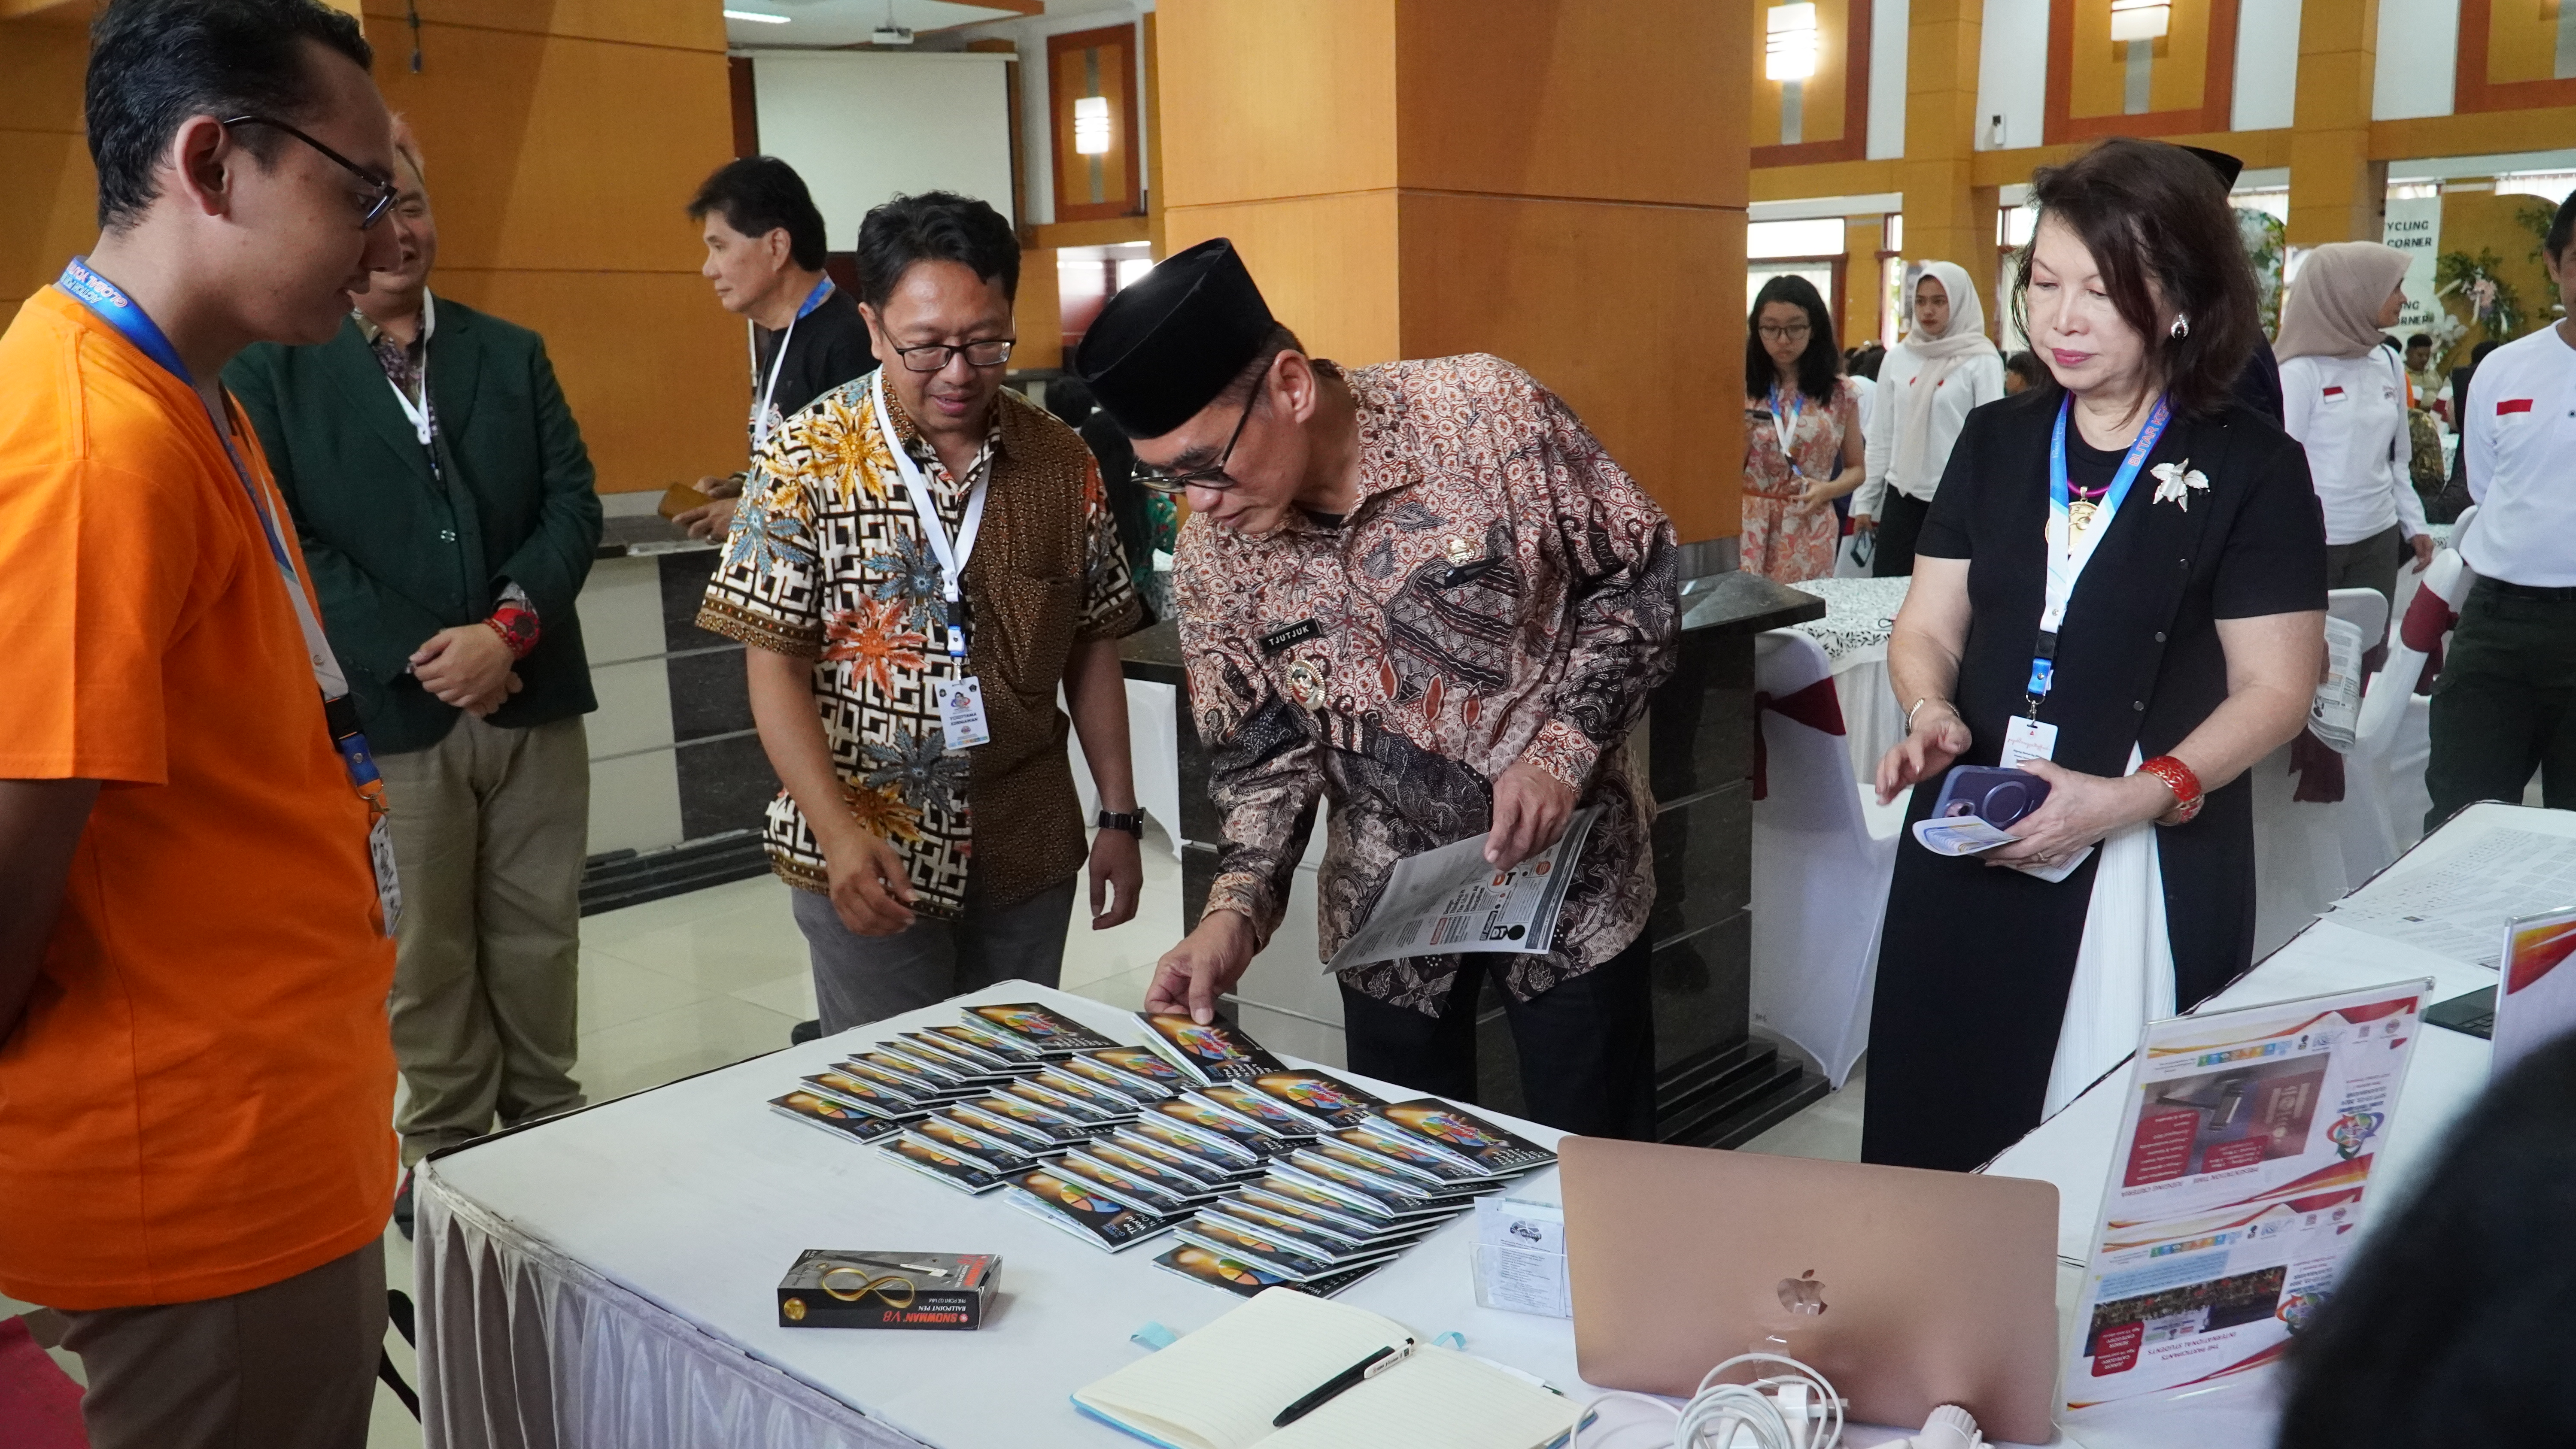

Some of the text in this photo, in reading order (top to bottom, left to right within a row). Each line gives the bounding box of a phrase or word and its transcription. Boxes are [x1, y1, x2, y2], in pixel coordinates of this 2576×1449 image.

[2387, 237, 2432, 248] CORNER
[86, 275, 128, 308] GLOBAL
[2127, 426, 2159, 467] BLITAR
[1268, 625, 1309, 646] TJUTJUK
[1492, 871, 1517, 886] DT
[1491, 928, 1507, 938] DT
[1492, 1151, 1514, 1164] World
[1500, 1150, 1515, 1158] Our
[1494, 1156, 1507, 1166] The
[1124, 1216, 1147, 1231] World
[1136, 1213, 1150, 1222] Our
[1123, 1223, 1138, 1235] The
[1295, 1282, 1322, 1295] World
[883, 1310, 959, 1323] SNOWMAN V8
[2148, 1331, 2237, 1355] INTERNATIONAL STUDENTS
[2161, 1347, 2205, 1361] PARTICIPANTS
